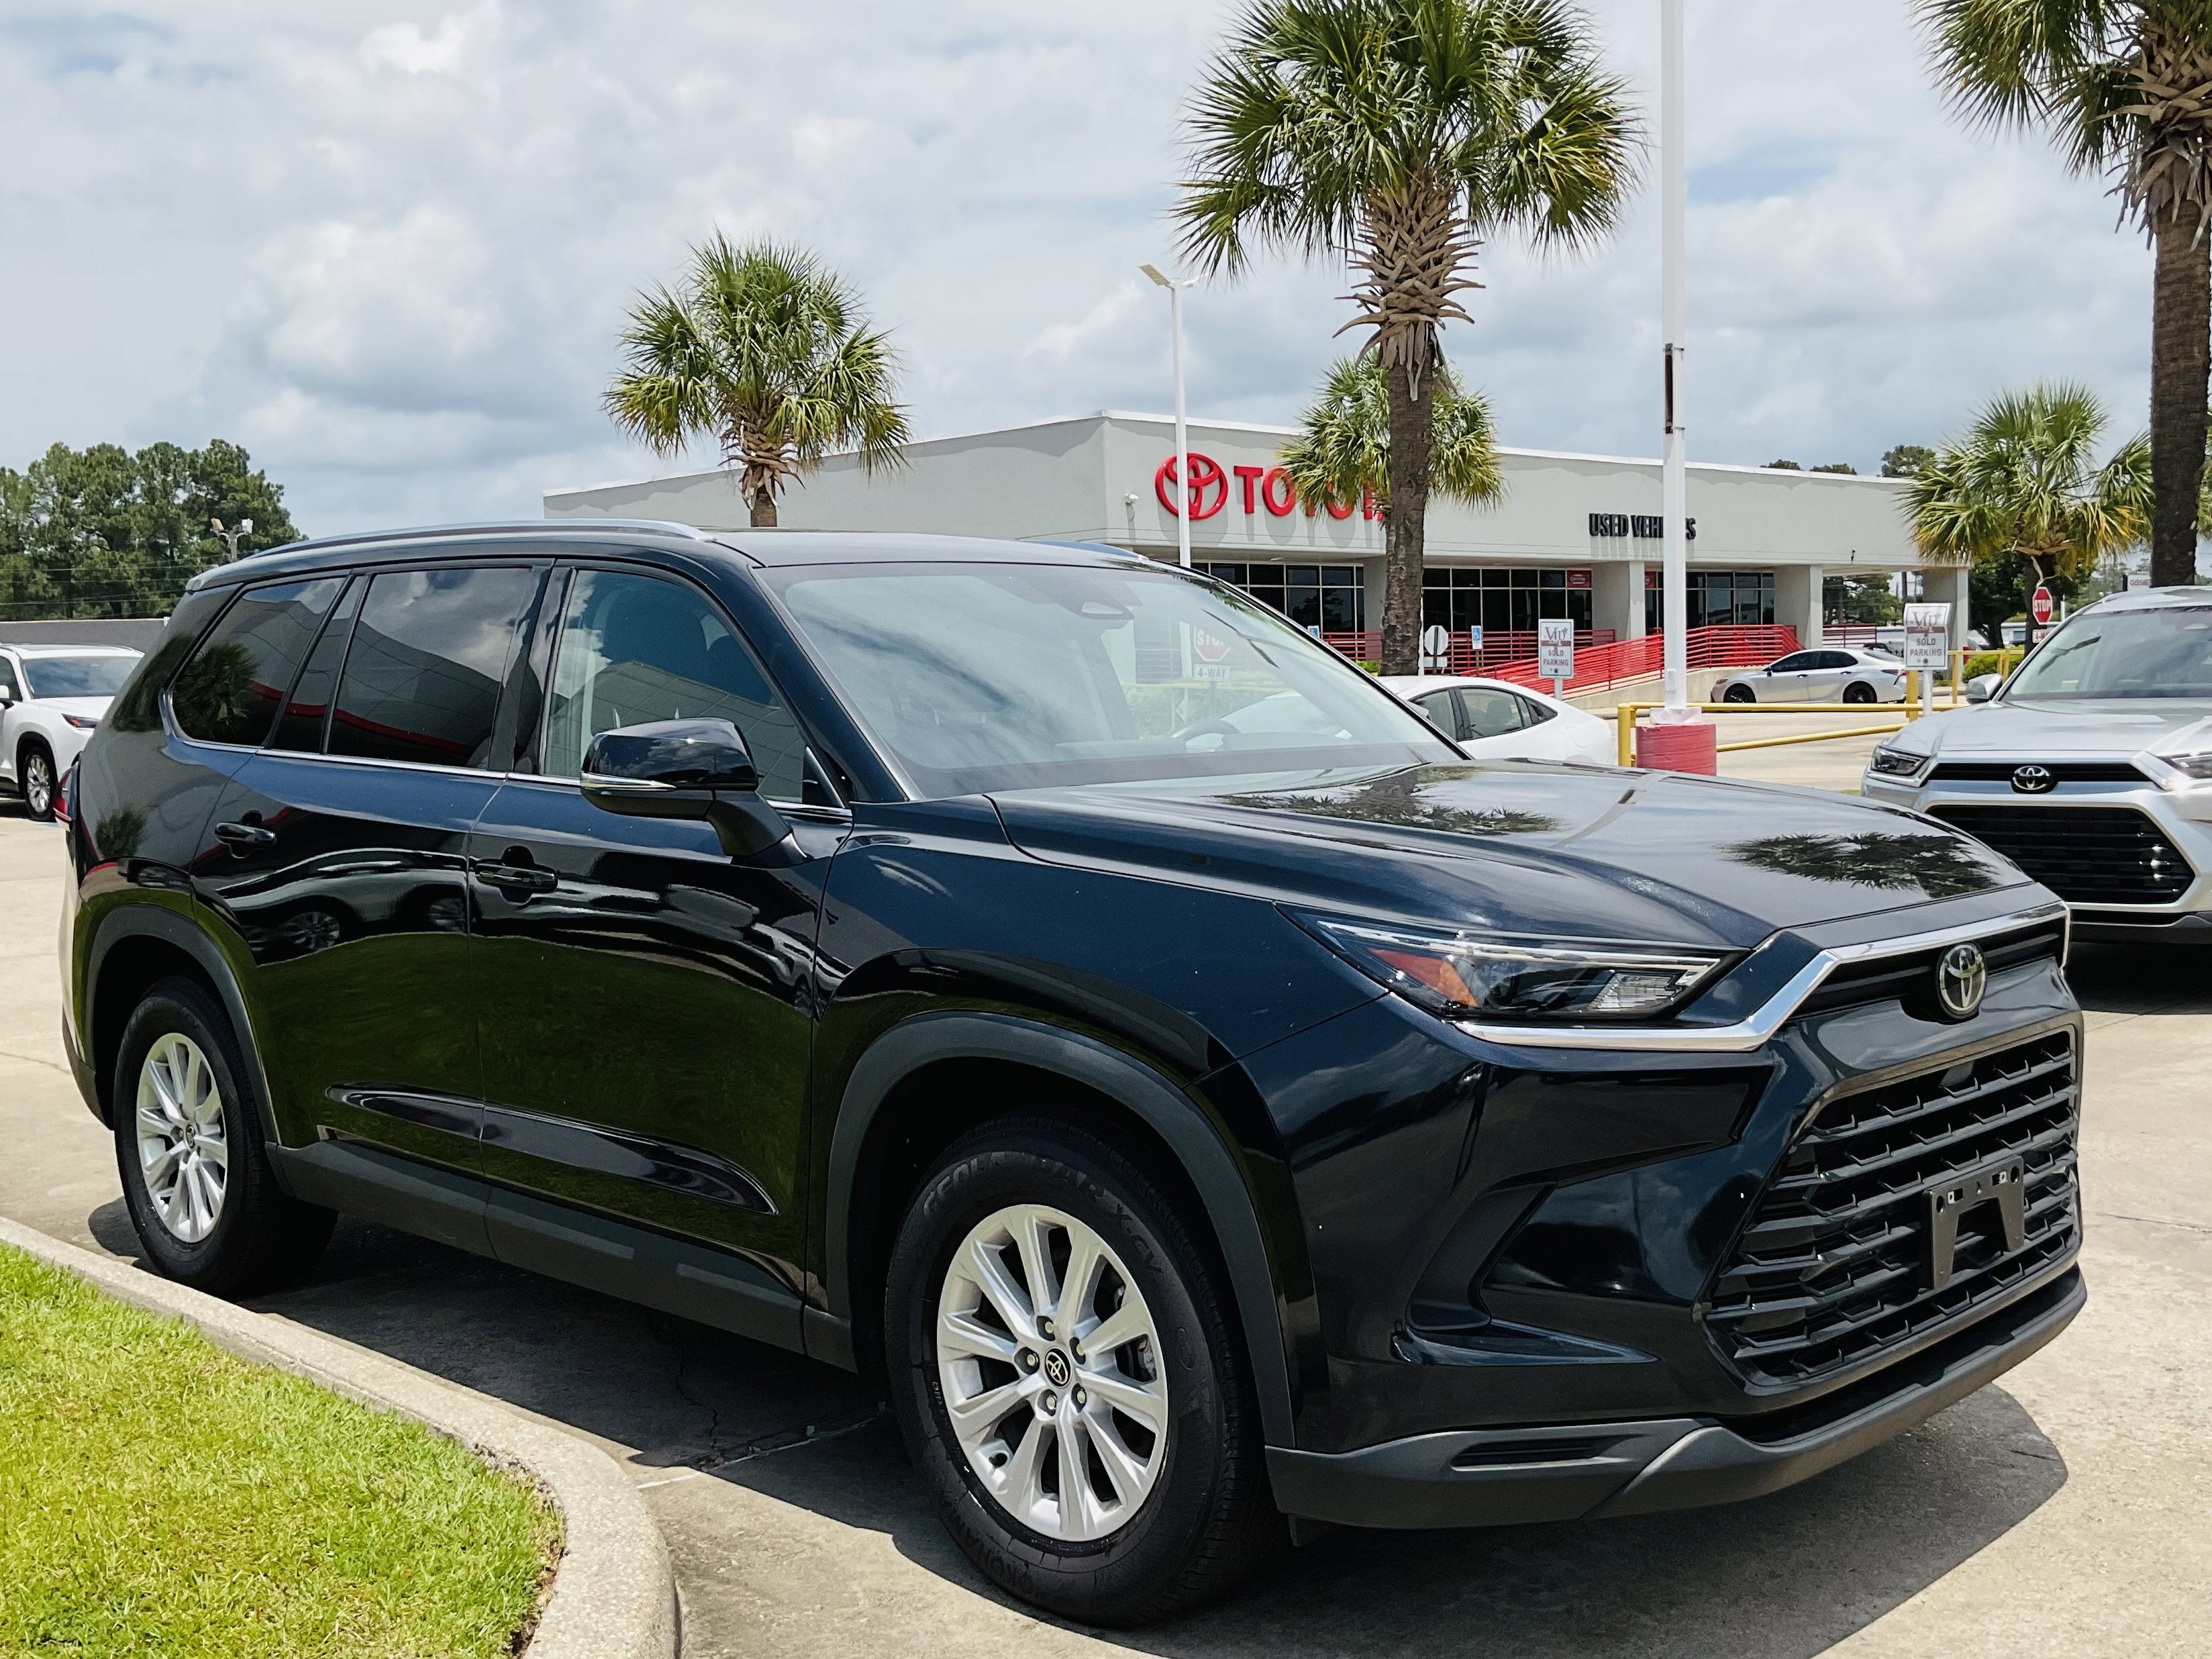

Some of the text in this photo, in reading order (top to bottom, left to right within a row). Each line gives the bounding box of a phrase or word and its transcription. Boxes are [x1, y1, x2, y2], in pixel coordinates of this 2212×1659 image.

[1234, 466, 1383, 520] TOO
[1589, 513, 1697, 540] USED VEHIS
[2034, 599, 2051, 612] STOP
[1917, 638, 1936, 646] SOLD
[1910, 648, 1942, 656] PARKING
[1197, 667, 1225, 678] 4-WAY
